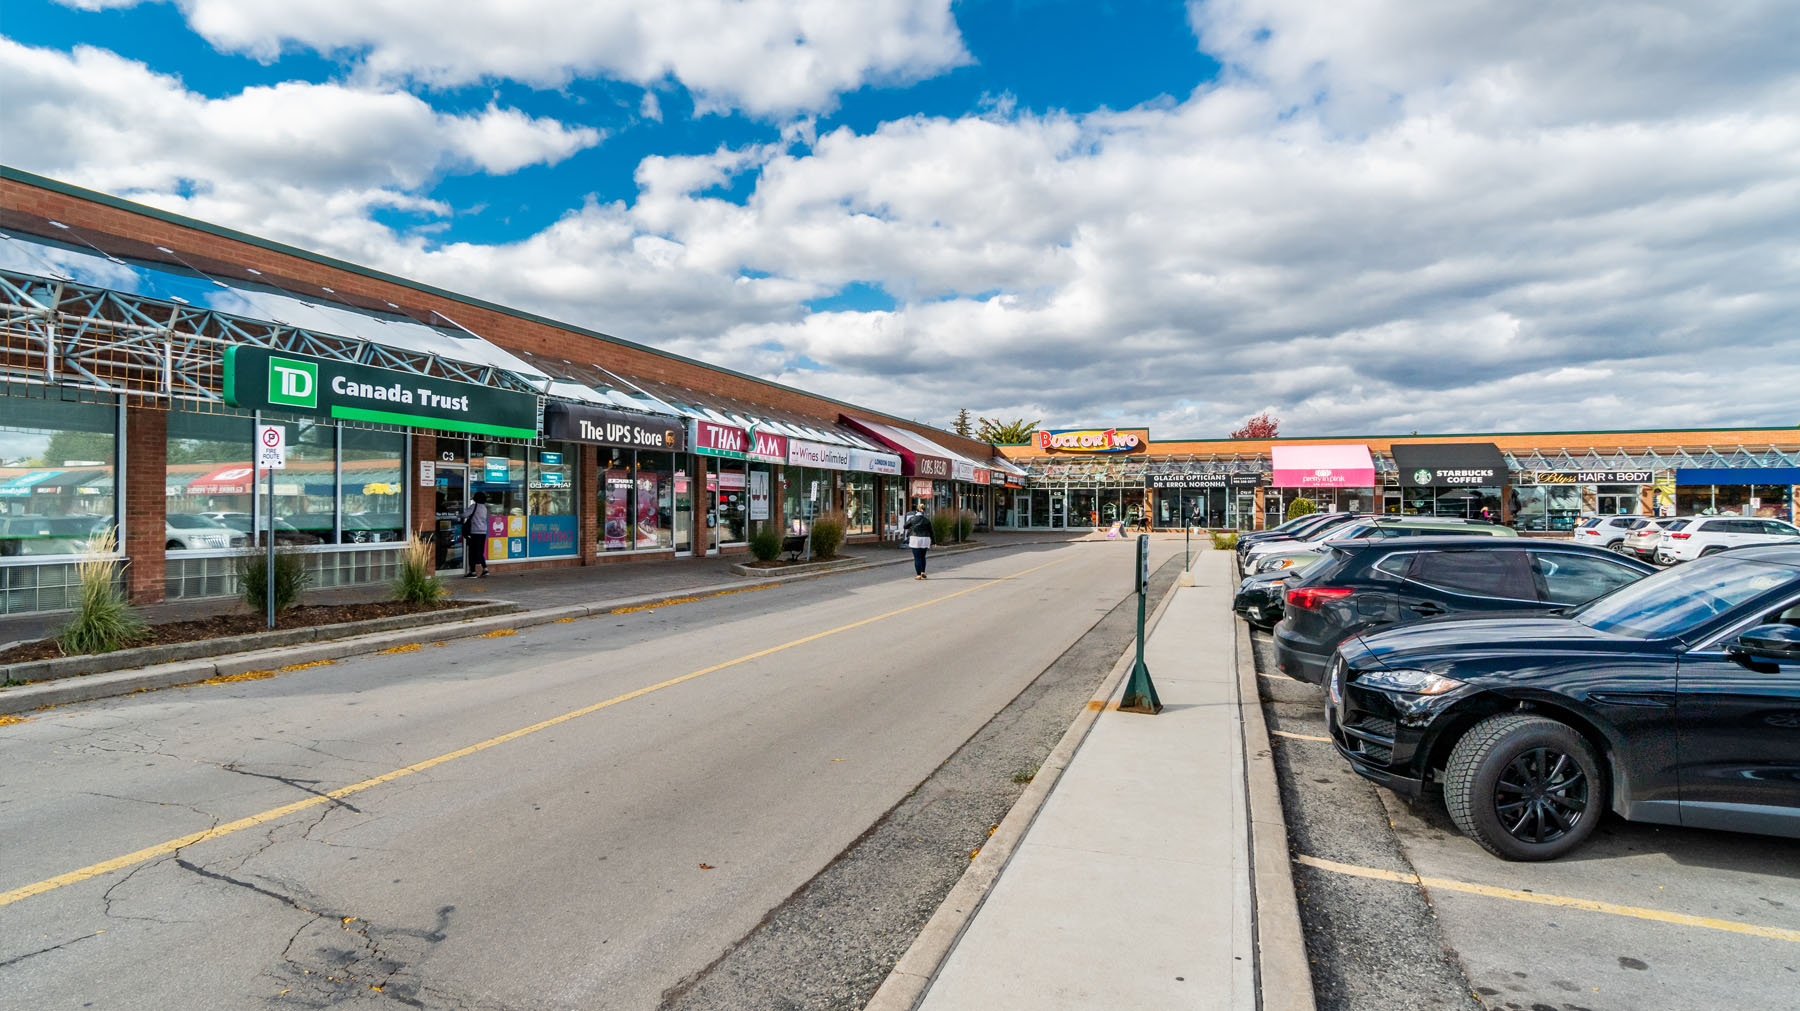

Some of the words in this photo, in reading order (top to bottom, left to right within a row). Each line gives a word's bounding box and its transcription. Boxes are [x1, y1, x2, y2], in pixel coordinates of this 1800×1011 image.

[274, 366, 313, 397] TD
[331, 376, 413, 403] Canada
[417, 388, 469, 412] Trust
[580, 420, 604, 440] The
[606, 423, 631, 443] UPS
[633, 427, 662, 446] Store
[1039, 431, 1080, 449] BUCK
[1080, 434, 1103, 447] OR
[1103, 429, 1139, 447] TWO
[442, 451, 455, 461] C3
[800, 447, 819, 462] Wines
[820, 449, 848, 465] Unlimited
[921, 458, 934, 474] COBS
[933, 460, 947, 476] BREAD
[1436, 469, 1494, 477] STARBUCKS
[1302, 475, 1322, 483] pretty
[1329, 475, 1345, 483] pink
[1446, 476, 1483, 484] COFFEE
[1537, 472, 1577, 484] Blyss
[1578, 471, 1606, 482] HAIR
[1616, 472, 1650, 481] BODY
[531, 531, 574, 544] PRINTING
